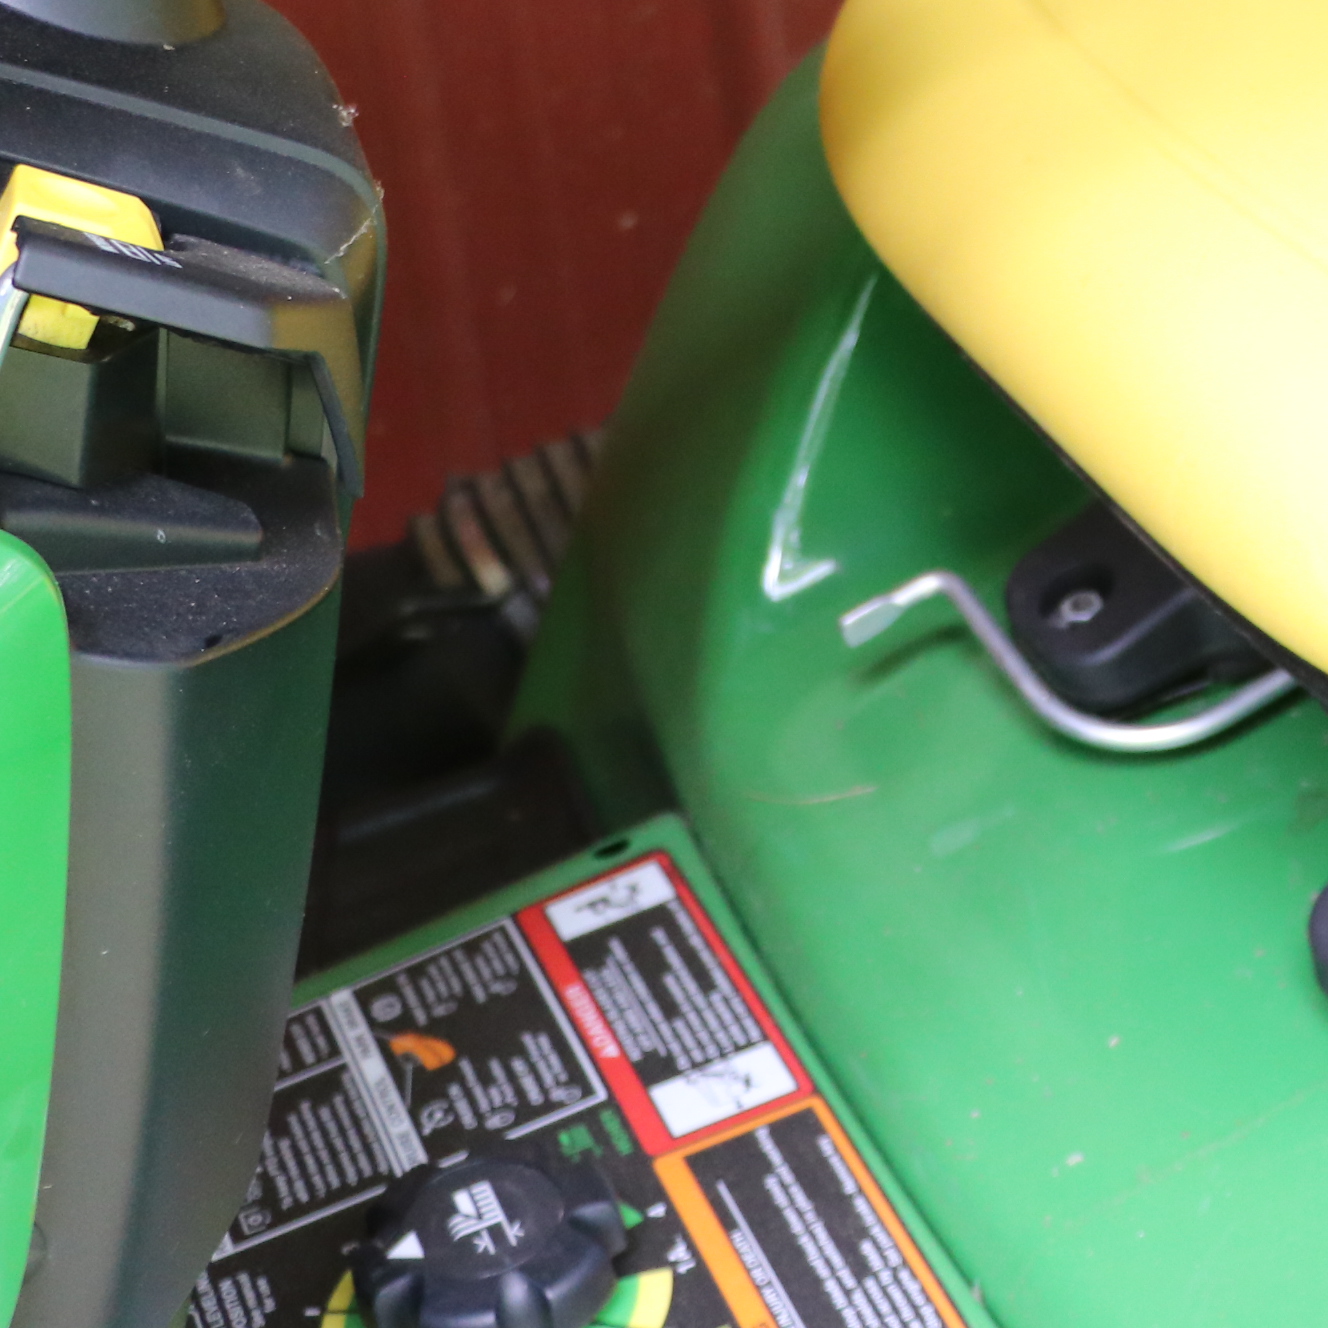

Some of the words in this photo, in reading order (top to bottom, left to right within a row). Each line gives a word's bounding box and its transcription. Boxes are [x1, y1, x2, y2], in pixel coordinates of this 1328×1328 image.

[563, 981, 612, 1047] DANGER
[729, 1229, 758, 1268] DEATH
[749, 1266, 768, 1286] OR
[219, 1279, 240, 1328] OSITION
